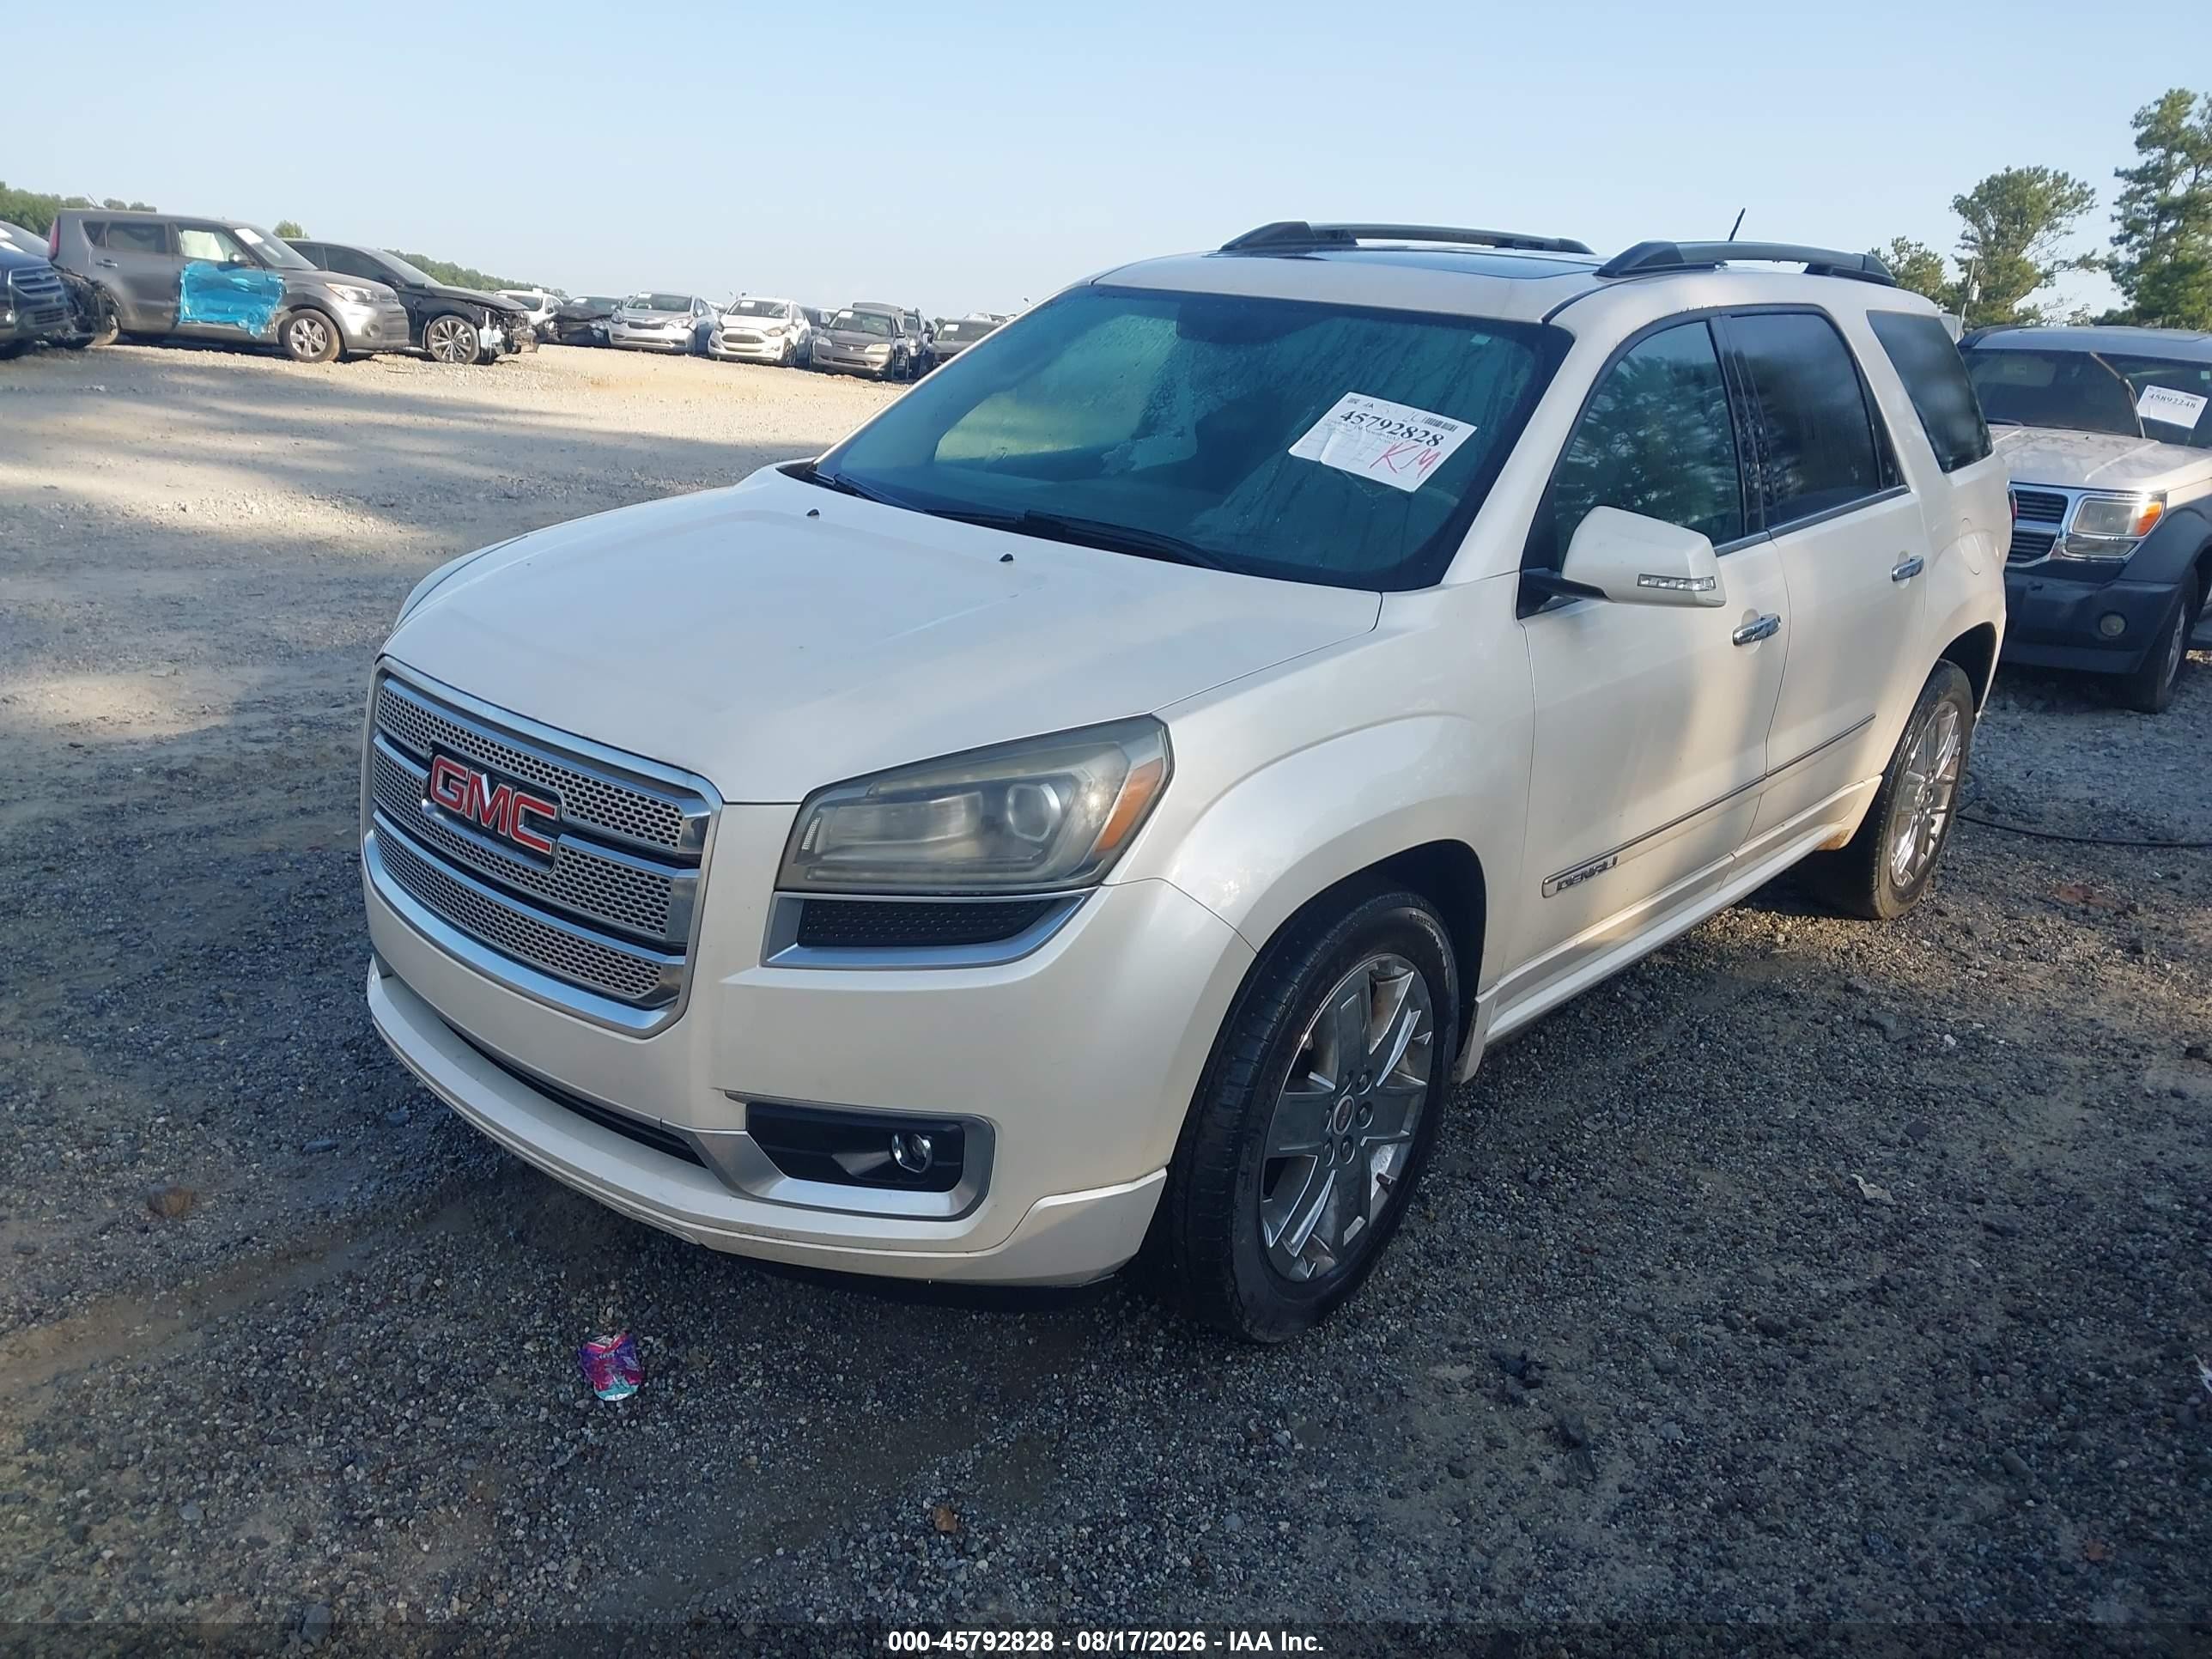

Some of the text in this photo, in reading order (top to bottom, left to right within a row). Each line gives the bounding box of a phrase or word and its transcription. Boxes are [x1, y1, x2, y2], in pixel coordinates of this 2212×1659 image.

[1340, 410, 1444, 447] 45792828
[1369, 442, 1441, 478] KM
[431, 754, 556, 855] GMC
